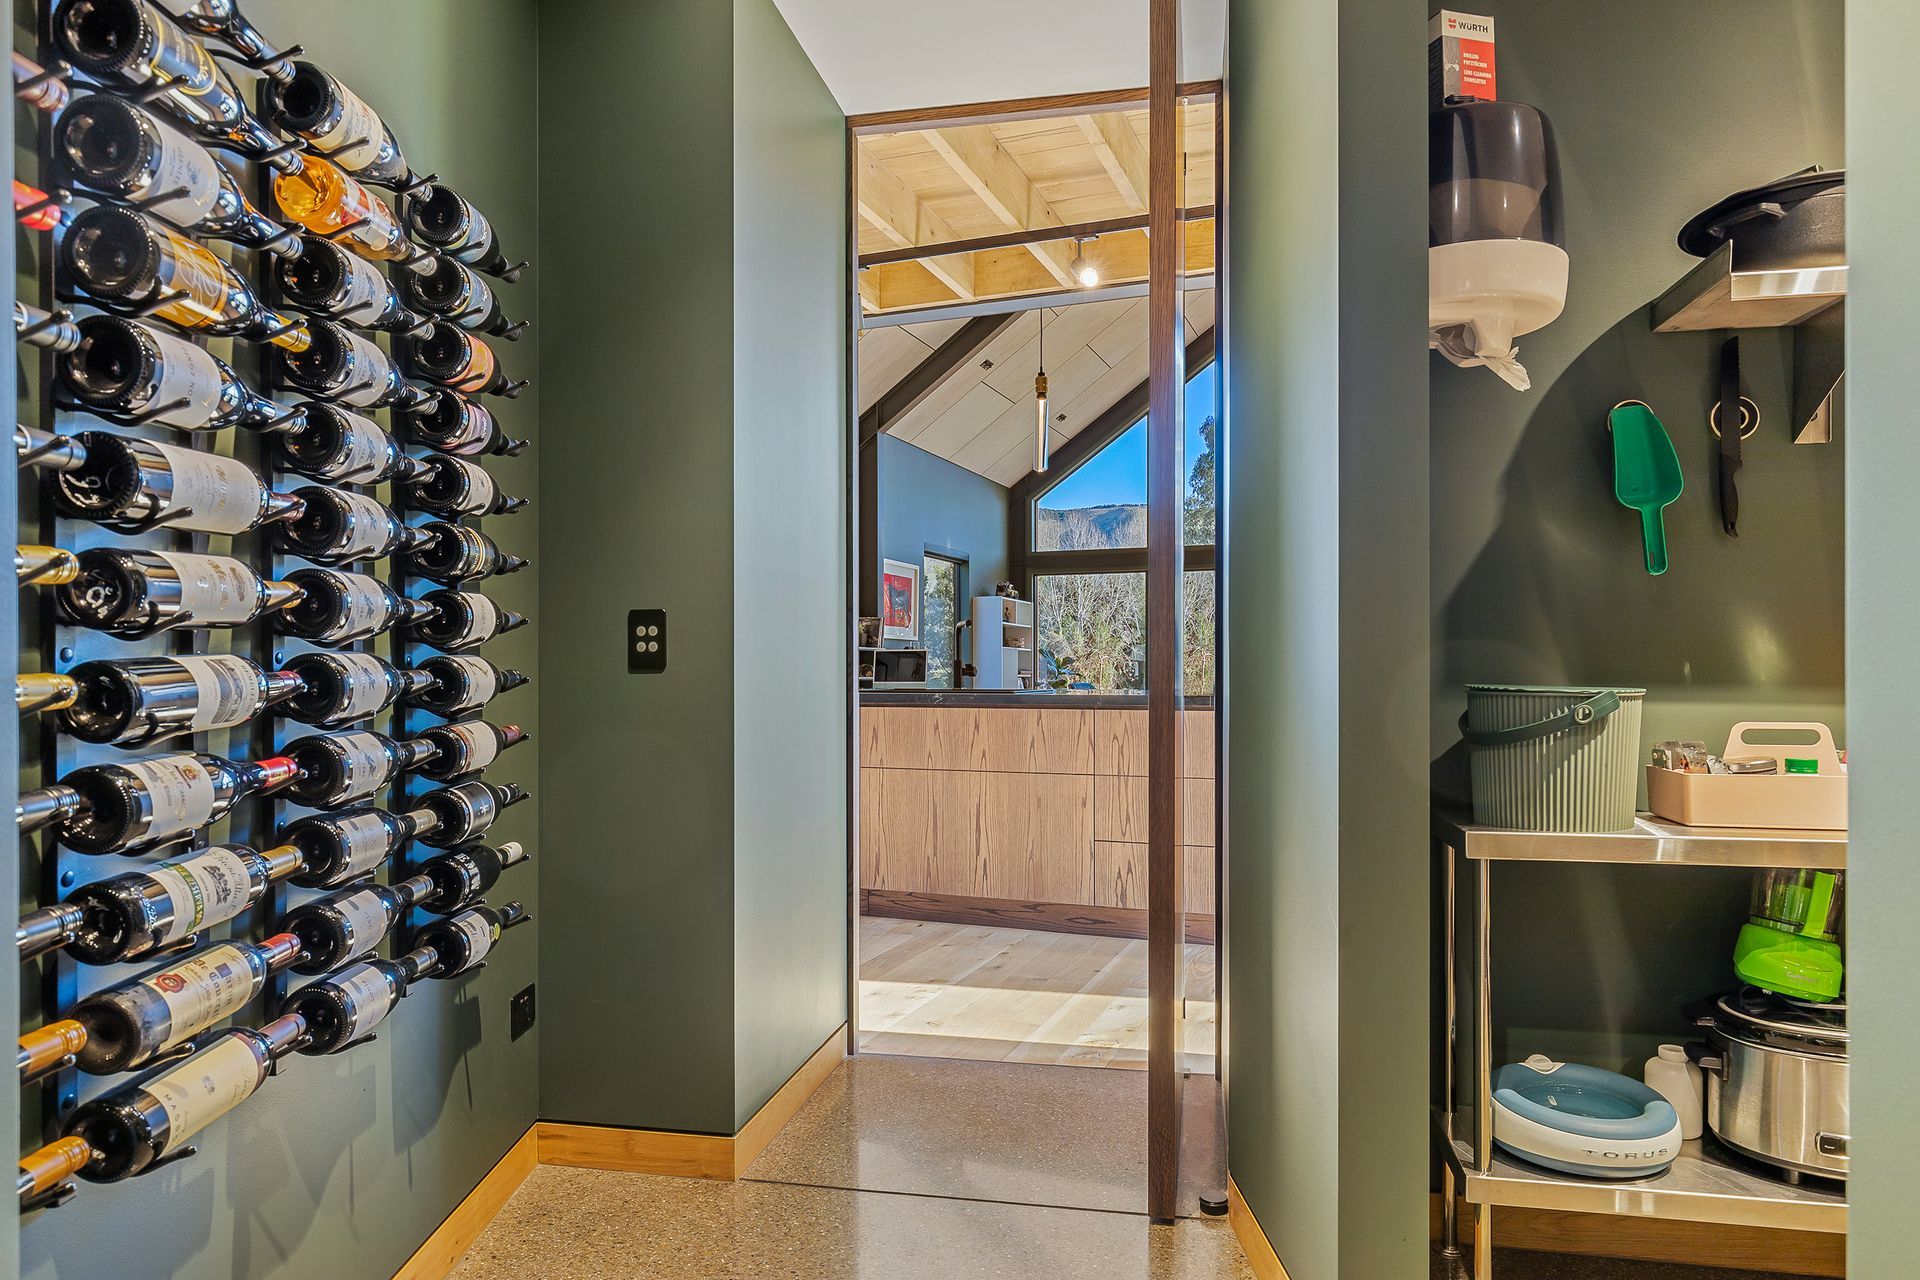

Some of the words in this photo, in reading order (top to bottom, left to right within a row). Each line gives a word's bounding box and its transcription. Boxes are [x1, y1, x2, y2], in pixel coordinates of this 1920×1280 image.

[1458, 21, 1489, 33] WÜRTH
[185, 876, 204, 912] RESERVA
[1580, 1147, 1668, 1159] TORUS
